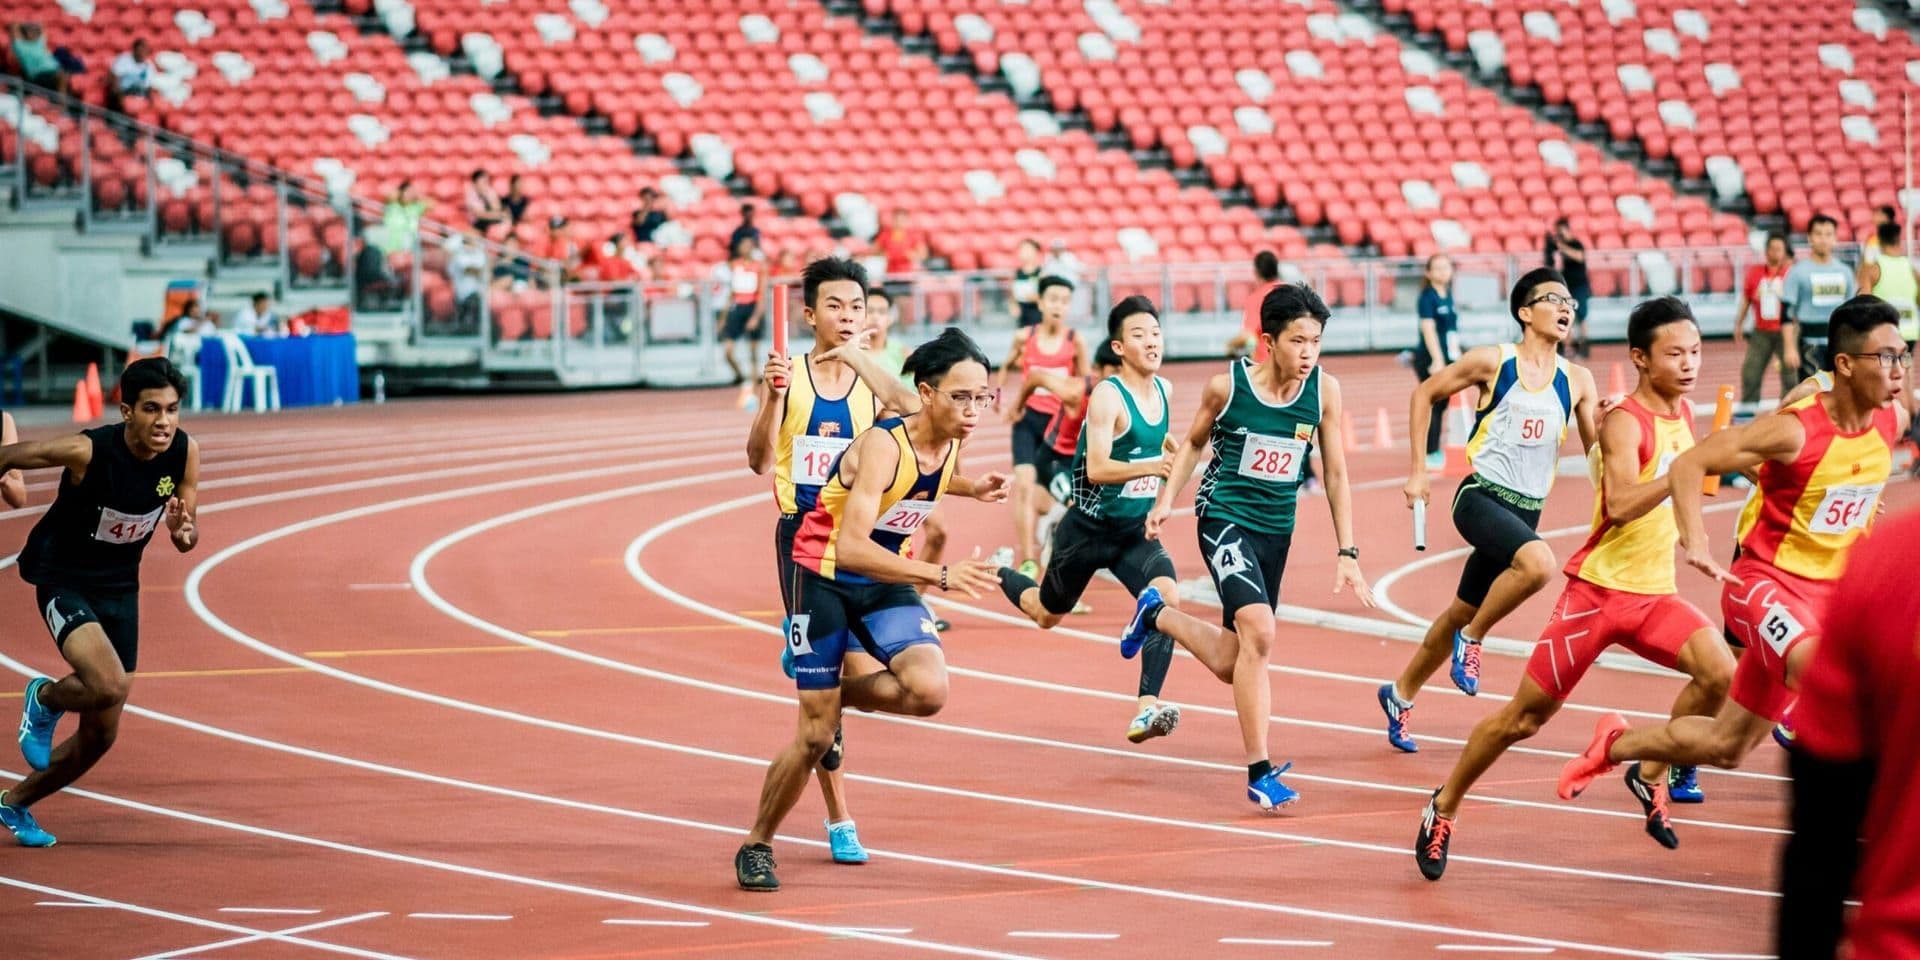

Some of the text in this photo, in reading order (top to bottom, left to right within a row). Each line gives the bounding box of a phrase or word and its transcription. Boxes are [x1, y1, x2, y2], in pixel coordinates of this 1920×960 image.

[1522, 419, 1544, 439] 50
[804, 451, 831, 477] 18
[1251, 449, 1291, 474] 282
[886, 511, 926, 528] 20
[1221, 549, 1235, 566] 4
[791, 622, 802, 648] 6
[1767, 616, 1788, 641] 5
